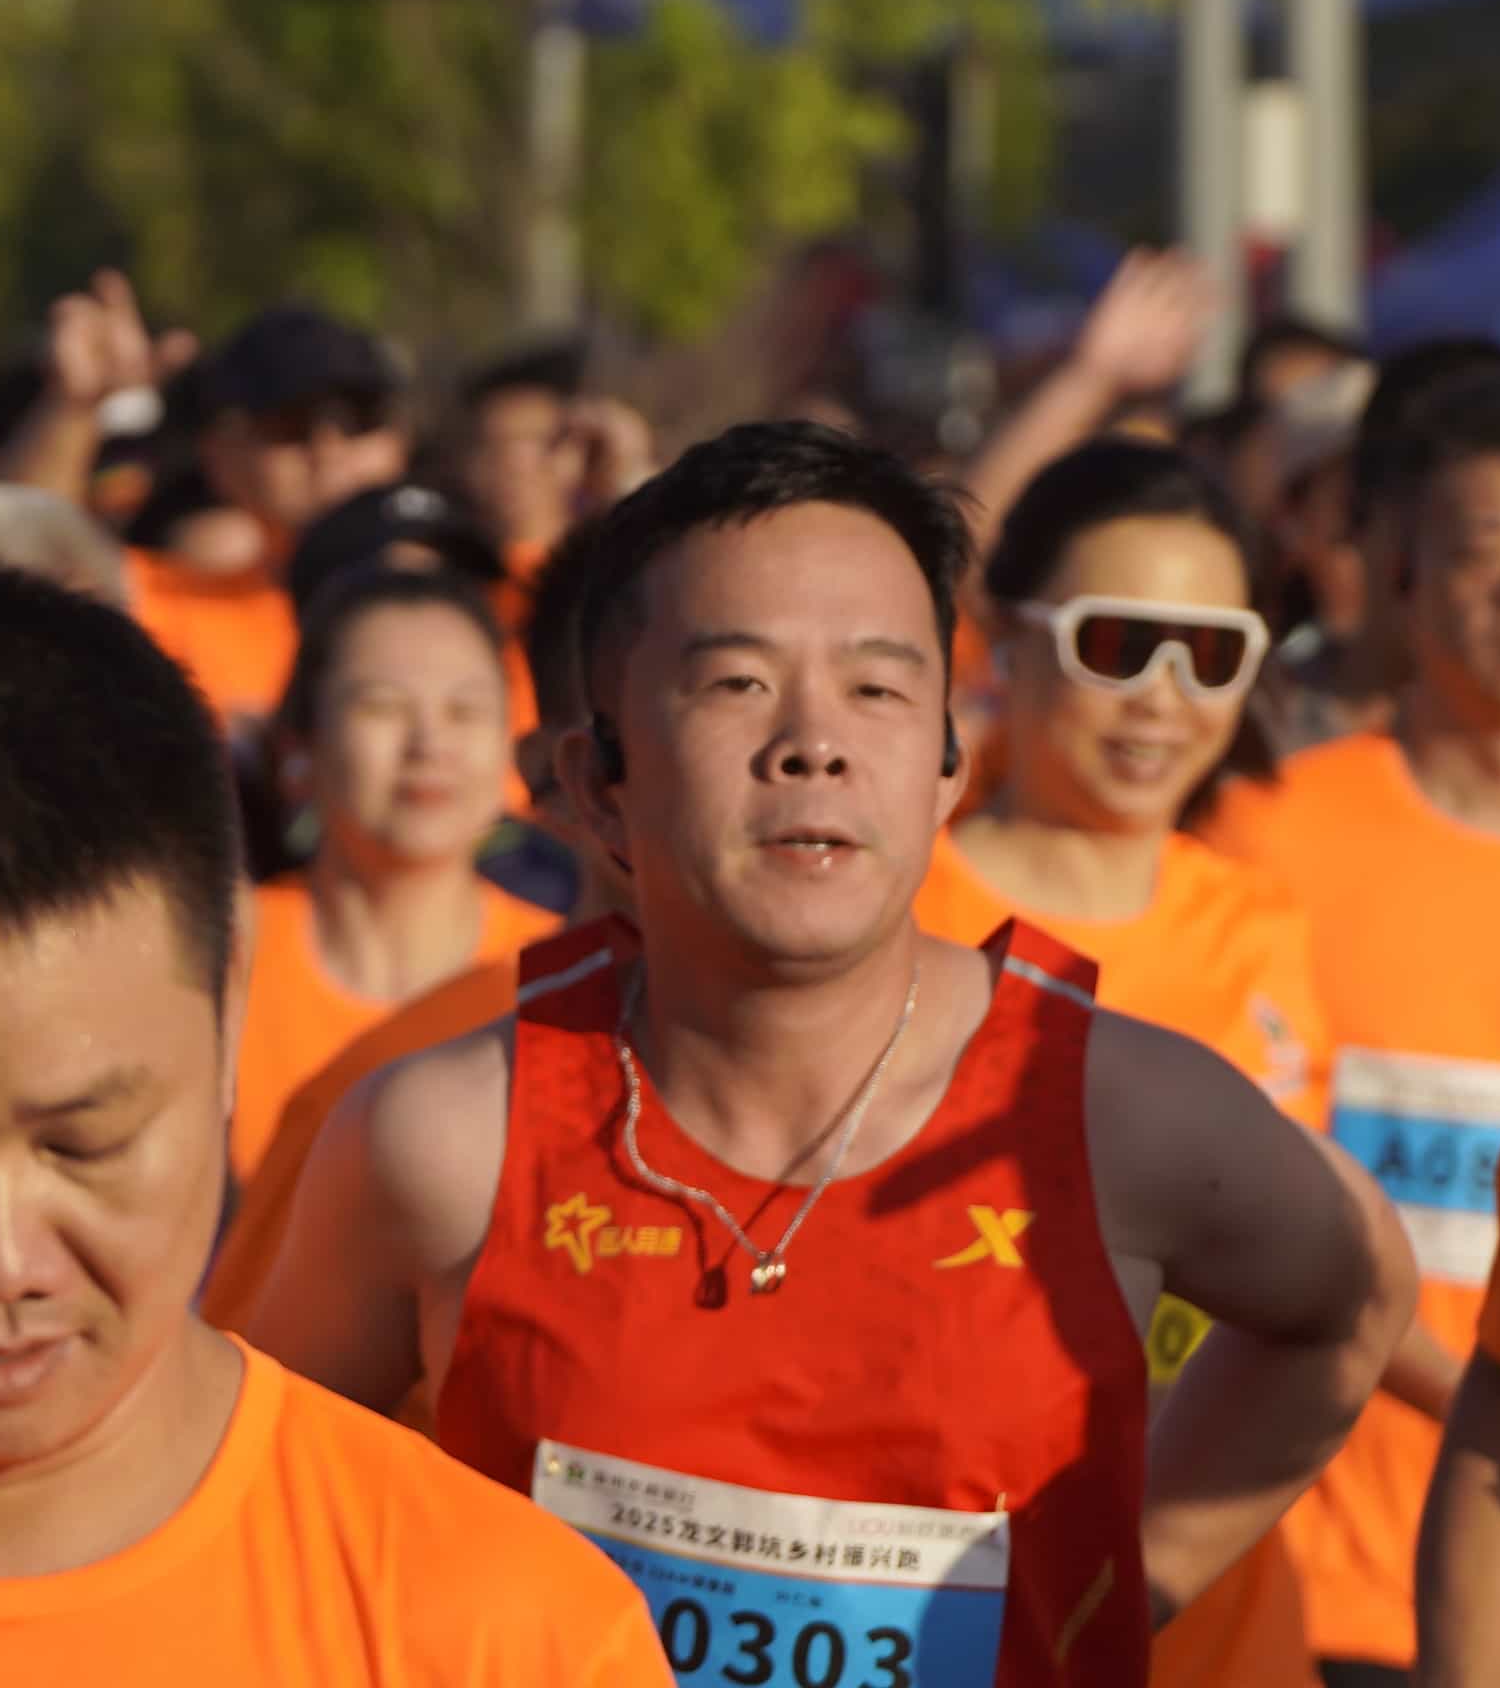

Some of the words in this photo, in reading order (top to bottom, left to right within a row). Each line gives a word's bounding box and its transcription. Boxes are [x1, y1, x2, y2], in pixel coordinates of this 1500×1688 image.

[611, 1502, 920, 1569] 2025龙文郭坑乡村振兴跑
[659, 1597, 914, 1688] 0303
